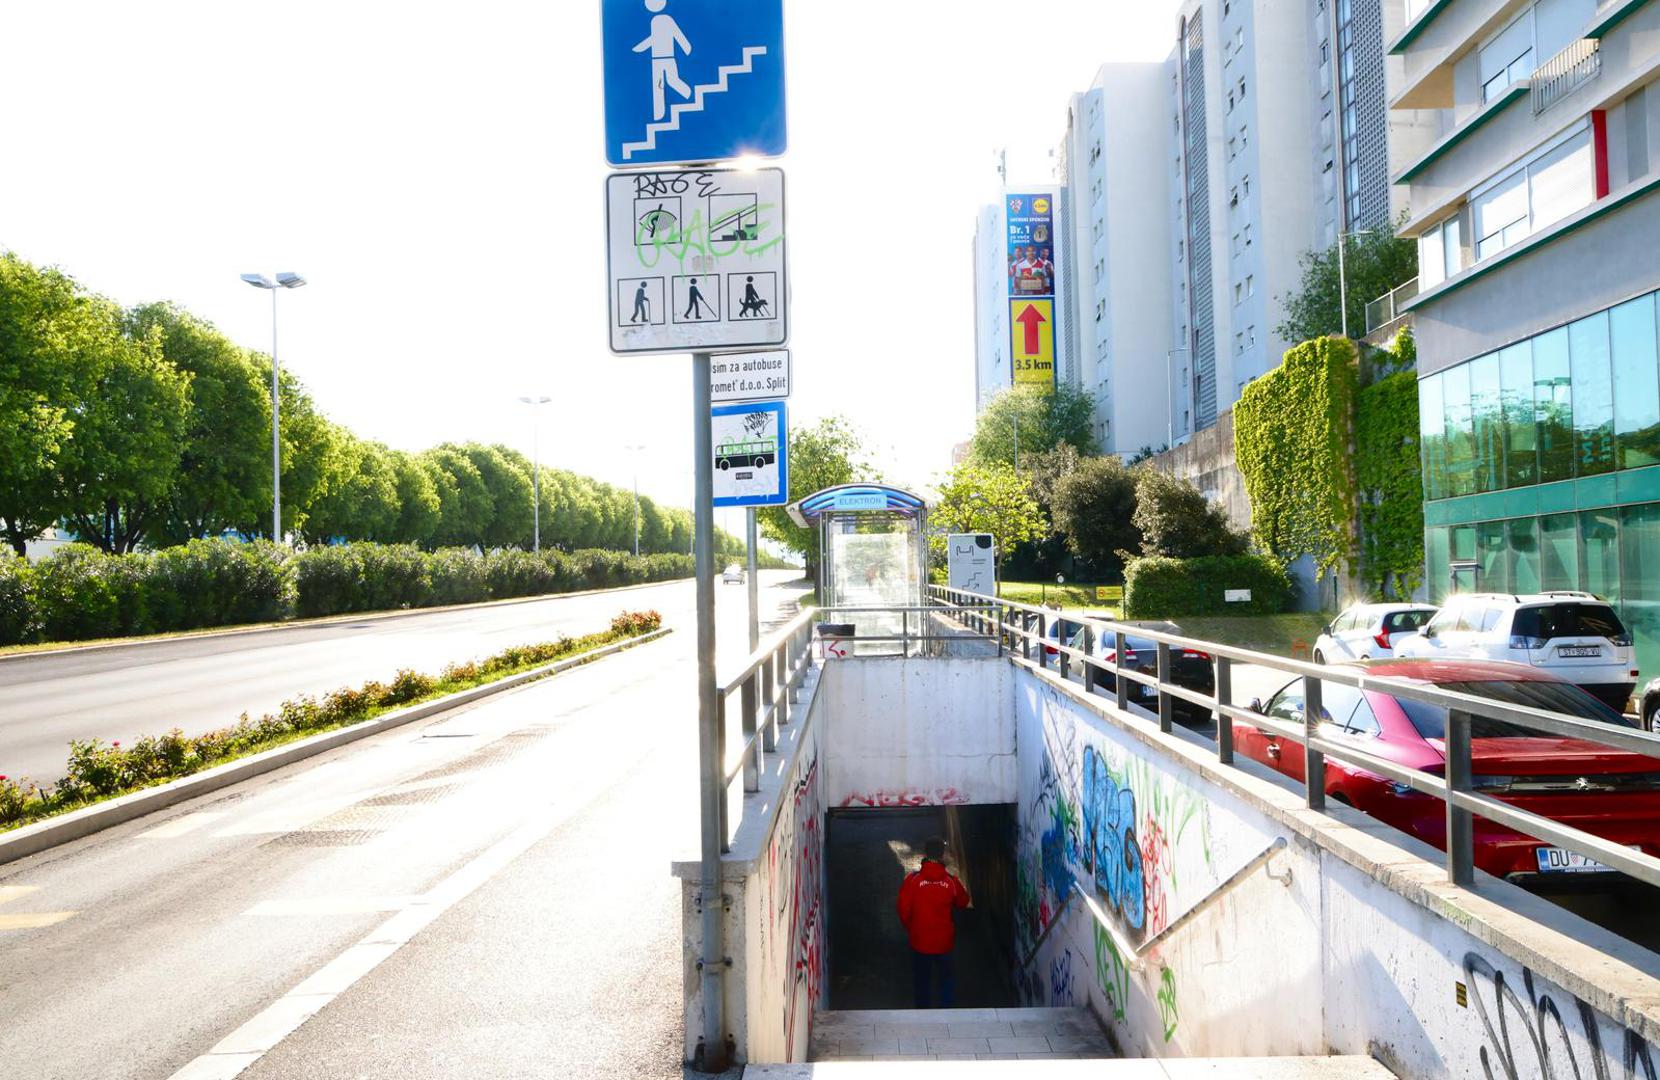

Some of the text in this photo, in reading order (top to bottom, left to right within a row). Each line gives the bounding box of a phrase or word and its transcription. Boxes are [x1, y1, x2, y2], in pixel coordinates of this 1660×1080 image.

[1010, 225, 1024, 234] Br.
[1024, 225, 1030, 234] 1
[712, 358, 782, 374] sim za autobuse
[1015, 359, 1052, 370] 3.5 km
[740, 380, 764, 391] d.o.o.
[766, 377, 786, 391] Split
[1550, 850, 1570, 867] DU
